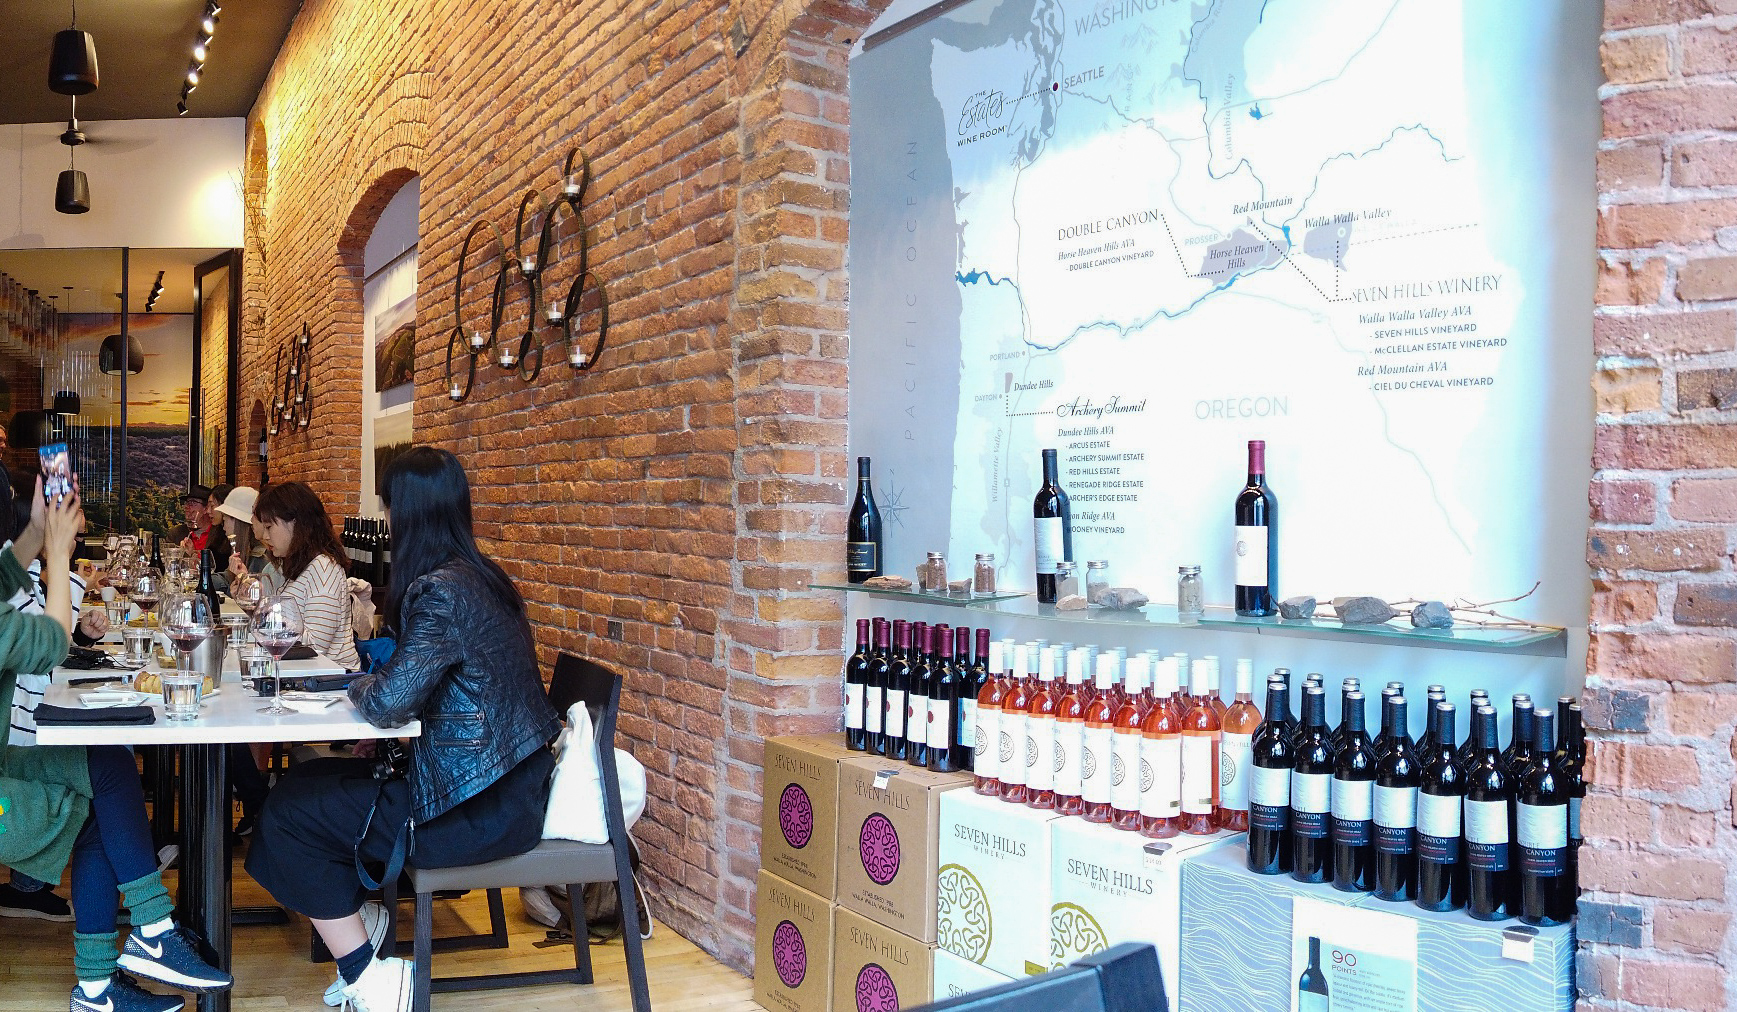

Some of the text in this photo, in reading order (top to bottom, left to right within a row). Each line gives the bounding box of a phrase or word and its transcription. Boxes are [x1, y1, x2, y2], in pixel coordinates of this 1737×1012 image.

[1064, 66, 1105, 89] SEATTLE
[975, 90, 986, 99] THE
[958, 89, 1005, 135] Estates
[1223, 73, 1236, 160] Columbia Valley
[957, 126, 1006, 147] WINE ROOM
[1233, 197, 1293, 215] Red Mountain
[1058, 208, 1158, 241] DOUBLE CANYON
[1305, 216, 1330, 229] Walla
[1333, 213, 1359, 225] Walla
[1184, 234, 1219, 246] PROSSER
[1058, 248, 1077, 261] Horse
[1077, 244, 1102, 258] Heaven
[1120, 238, 1135, 249] AVA
[1209, 244, 1264, 260] Horse Heaven
[1069, 251, 1154, 272] DOUBLE CANYON VINEYARD
[1227, 259, 1246, 269] Hills
[904, 142, 917, 440] PACIFIC OCEAN
[1352, 285, 1388, 303] SEVEN
[1438, 274, 1502, 295] WINERY
[1359, 306, 1472, 325] Walla Walla Valley AVA
[1375, 323, 1477, 339] SEVEN HILLS VINEYARD
[1374, 338, 1507, 355] McCLELLAN ESTATE VINEYARD
[989, 351, 1020, 361] PORTLAND
[1357, 361, 1447, 376] Red Mountain AVA
[1014, 380, 1054, 391] Dundee Hills
[1374, 377, 1494, 391] CIEL DU CHEVAL VINEYARD
[974, 394, 997, 402] DAYTON
[1057, 396, 1146, 419] Archery Summit
[1195, 395, 1288, 419] OREGON
[1058, 426, 1114, 437] Dundee Hills AVA
[991, 427, 1004, 503] Willamette Valley
[1081, 512, 1100, 522] Ridge
[1101, 512, 1115, 520] AVA
[1094, 526, 1125, 534] VINEYARD
[775, 753, 822, 781] SEVEN HILLS
[855, 779, 910, 811] SEVEN HILLS
[1296, 812, 1321, 820] CANYON
[1335, 820, 1362, 828] CANYON
[1379, 827, 1406, 835] CANYON
[954, 824, 1026, 857] SEVEN HILLS
[1420, 835, 1447, 845] CANYON
[1468, 843, 1496, 851] CANYON
[973, 845, 1005, 860] WINERY
[1068, 859, 1153, 895] SEVEN HILLS
[1090, 881, 1128, 898] WINERY
[769, 887, 814, 922] SEVEN HILLS
[850, 926, 909, 966] SEVEN HILLS
[1332, 950, 1356, 966] 90
[1332, 965, 1356, 976] POINTS
